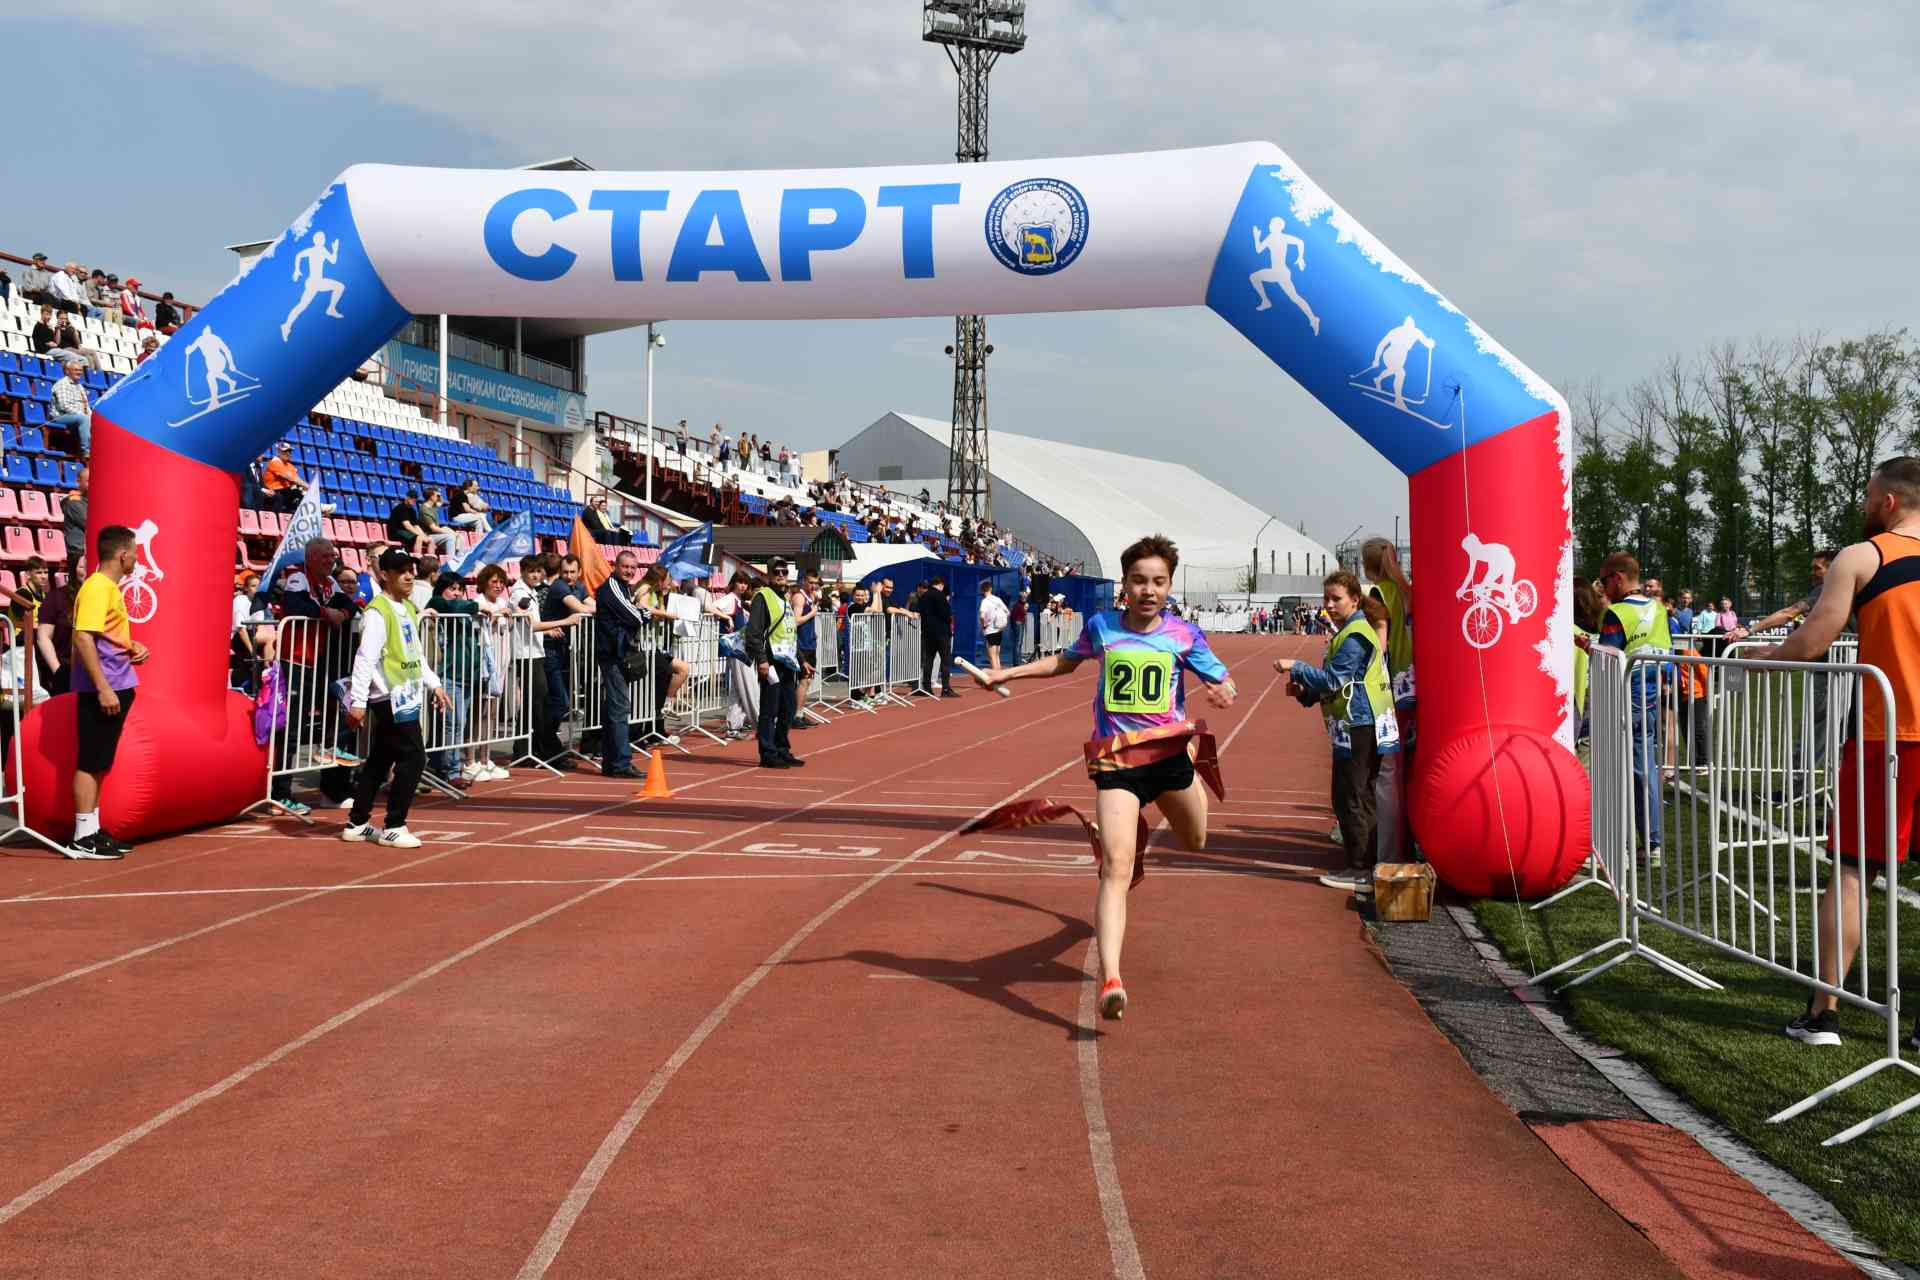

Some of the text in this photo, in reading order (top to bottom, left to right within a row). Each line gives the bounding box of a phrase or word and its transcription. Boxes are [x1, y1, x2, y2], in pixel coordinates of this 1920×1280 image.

[484, 183, 961, 281] СТАРТ
[403, 359, 439, 385] ПРИВЕТ
[447, 371, 496, 400] ЧАСТНИКАМ
[1109, 660, 1165, 705] 20
